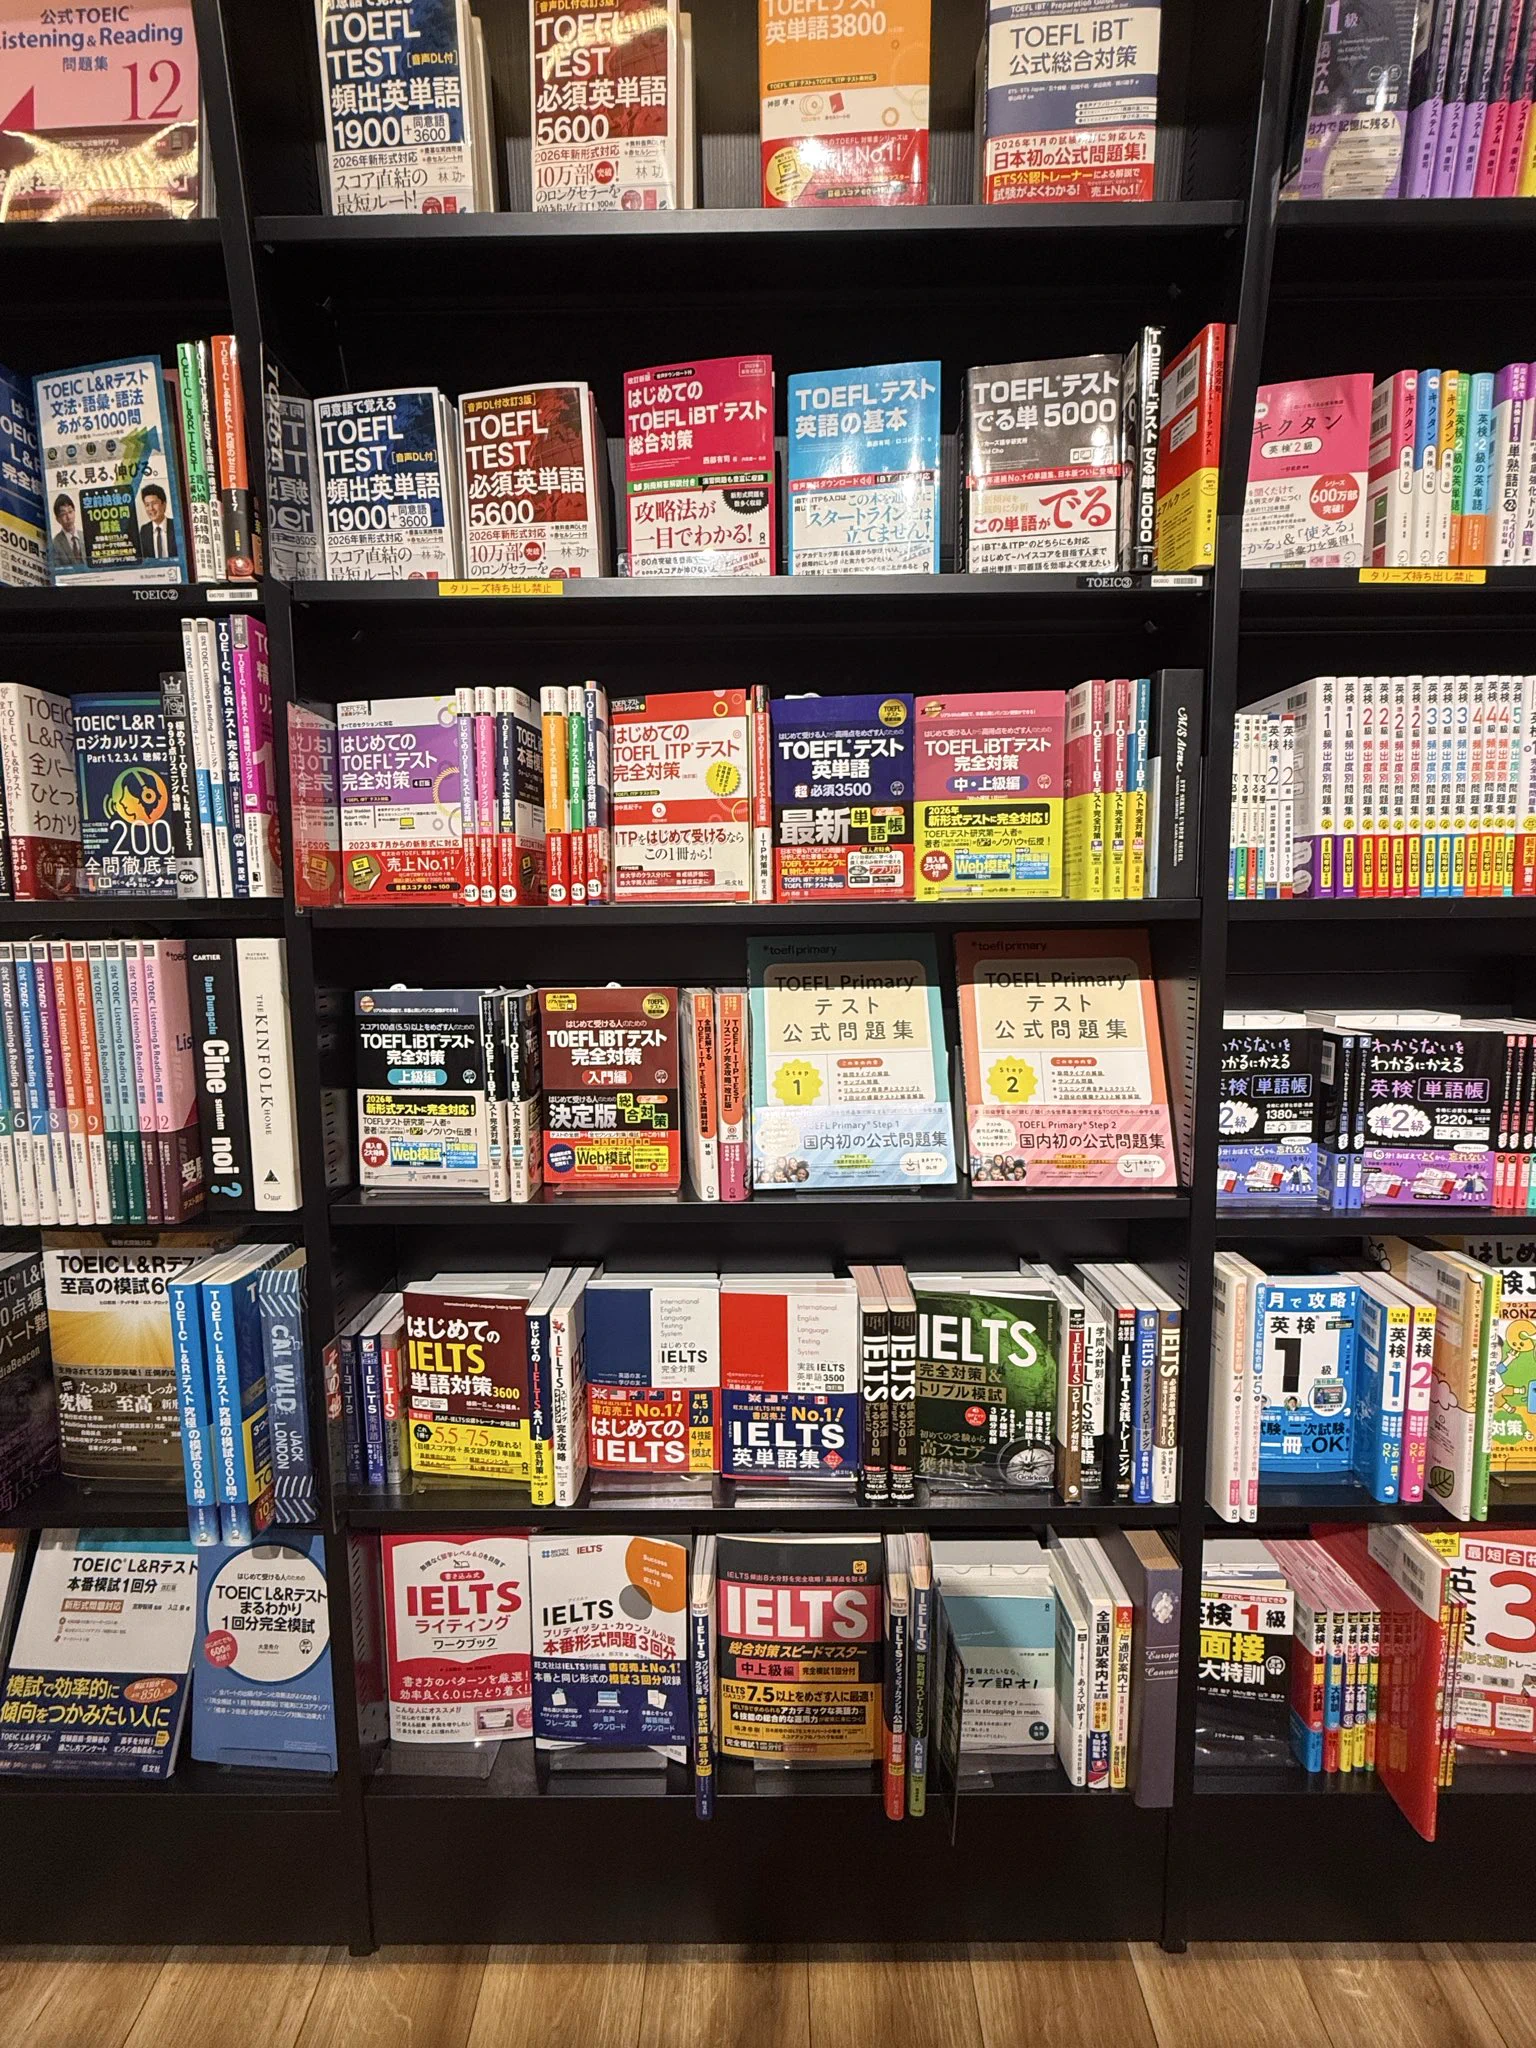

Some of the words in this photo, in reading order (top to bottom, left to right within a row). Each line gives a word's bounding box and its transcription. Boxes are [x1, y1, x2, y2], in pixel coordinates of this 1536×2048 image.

[0, 30, 84, 50] istening
[87, 37, 96, 47] &
[100, 24, 183, 45] Reading
[326, 12, 421, 46] TOEFL
[1010, 23, 1084, 49] TOEFL
[62, 56, 108, 72] 問題集
[328, 46, 402, 79] TEST
[1010, 45, 1137, 76] 公式総合対策
[122, 60, 183, 121] 12
[331, 76, 460, 115] 頻出英単語
[536, 76, 666, 114] 必須英単語
[413, 114, 445, 130] 同意語
[538, 115, 609, 145] 5600
[334, 119, 398, 150] 1900
[414, 128, 445, 142] 3600
[333, 151, 417, 168] 2026年新形式対応
[994, 143, 1147, 171] 日本初の公式問題集!
[336, 168, 427, 191] スコア直結の
[628, 380, 703, 409] はじめての
[319, 397, 396, 418] 同意語で覚える
[1404, 394, 1415, 442] キクタン
[57, 409, 141, 436] あがる1000問
[322, 415, 403, 446] TOEFL
[464, 410, 548, 441] TOEFL
[795, 407, 907, 440] 英語の基本
[1253, 414, 1343, 439] キクタン
[628, 429, 693, 456] 総合対策
[323, 446, 386, 475] TEST
[466, 440, 531, 470] TEST
[56, 459, 159, 488] 解く、見る、伸びる。
[469, 466, 585, 500] 必須英単語
[327, 471, 440, 505] 頻出英単語
[1311, 488, 1357, 504] 600万部
[329, 505, 387, 532] 1900
[398, 505, 427, 516] 同意語
[470, 500, 534, 527] 5600
[634, 499, 716, 523] 攻略法が
[1039, 486, 1112, 529] でる
[1323, 504, 1344, 515] 突破!
[399, 516, 428, 527] 3600
[973, 514, 1050, 534] この単語が
[328, 531, 403, 546] 2026年新形式対応
[469, 528, 547, 541] 2026年新形式対応
[635, 523, 753, 550] 一目でわかる!
[330, 547, 412, 564] スコア直結の
[1370, 571, 1474, 583] タリーズ持ち出し禁止
[449, 583, 552, 595] タリーズ持ち出し禁止
[340, 733, 416, 753] はじめての
[613, 723, 689, 744] はじめての
[613, 762, 680, 782] 完全対策
[812, 759, 870, 779] 英単語
[954, 754, 1018, 772] 完全対策
[341, 772, 410, 792] 完全対策
[954, 776, 1021, 792] 中・上級編
[110, 819, 171, 856] 200
[780, 807, 850, 845] 最新
[348, 838, 459, 849] 2023年7月からの新形式に対応
[645, 846, 713, 861] この1冊から!
[774, 976, 835, 992] TOEFL
[840, 975, 915, 992] Primary
[984, 973, 1046, 989] TOEFL
[1052, 972, 1128, 990] Primary
[256, 994, 264, 1013] THE
[815, 997, 880, 1015] テスト
[1027, 994, 1091, 1012] テスト
[783, 1020, 914, 1043] 公式問題集
[995, 1019, 1128, 1040] 公式問題集
[386, 1050, 446, 1065] 完全対策
[571, 1049, 643, 1066] 完全対策
[1372, 1037, 1464, 1055] わからないを
[202, 1039, 230, 1094] Cine
[256, 1014, 273, 1108] KINFOLK
[1371, 1055, 1464, 1073] わかるにかえる
[398, 1070, 437, 1084] 上級編
[588, 1071, 627, 1084] 入門編
[1423, 1080, 1485, 1100] 単語帳
[264, 1109, 272, 1135] HOME
[549, 1104, 618, 1128] 決定版
[1018, 1120, 1046, 1129] TOEFL
[1089, 1121, 1109, 1130] Step
[1111, 1121, 1116, 1129] 2
[1375, 1109, 1424, 1133] 準2級
[803, 1131, 948, 1150] 国内初の公式問題集
[1020, 1133, 1166, 1149] 国内初の公式問題集
[211, 1136, 239, 1175] noi
[407, 1316, 500, 1344] はじめての
[919, 1314, 1038, 1368] IELTS
[408, 1340, 485, 1374] IELTS
[661, 1350, 708, 1364] IELTS
[1161, 1328, 1179, 1377] IELTS
[919, 1363, 983, 1380] 完全対策
[1275, 1338, 1301, 1392] 1
[1321, 1365, 1331, 1375] 級
[919, 1381, 1004, 1402] トリプル模試
[591, 1419, 685, 1439] はじめての
[691, 1430, 711, 1441] 4技能
[732, 1421, 845, 1449] IELTS
[275, 1423, 289, 1470] LONDON
[290, 1431, 303, 1462] JACK
[596, 1440, 686, 1464] IELTS
[692, 1449, 711, 1457] 模試
[732, 1449, 820, 1469] 英単語集
[577, 1545, 603, 1554] IELTS
[67, 1577, 157, 1593] 本番模試1回分
[240, 1601, 301, 1616] まるわかり
[407, 1582, 522, 1616] IELTS
[543, 1600, 613, 1626] IELTS
[727, 1585, 869, 1639] IELTS
[222, 1616, 315, 1634] 1回分完全模試
[415, 1615, 511, 1634] ライティング
[434, 1638, 496, 1649] ワークブック
[1200, 1631, 1265, 1662] 面接
[1199, 1661, 1265, 1686] 大特訓
[6, 1676, 120, 1699] 模試で効率的に
[0, 1703, 170, 1727] 傾向をつかみたい人に
